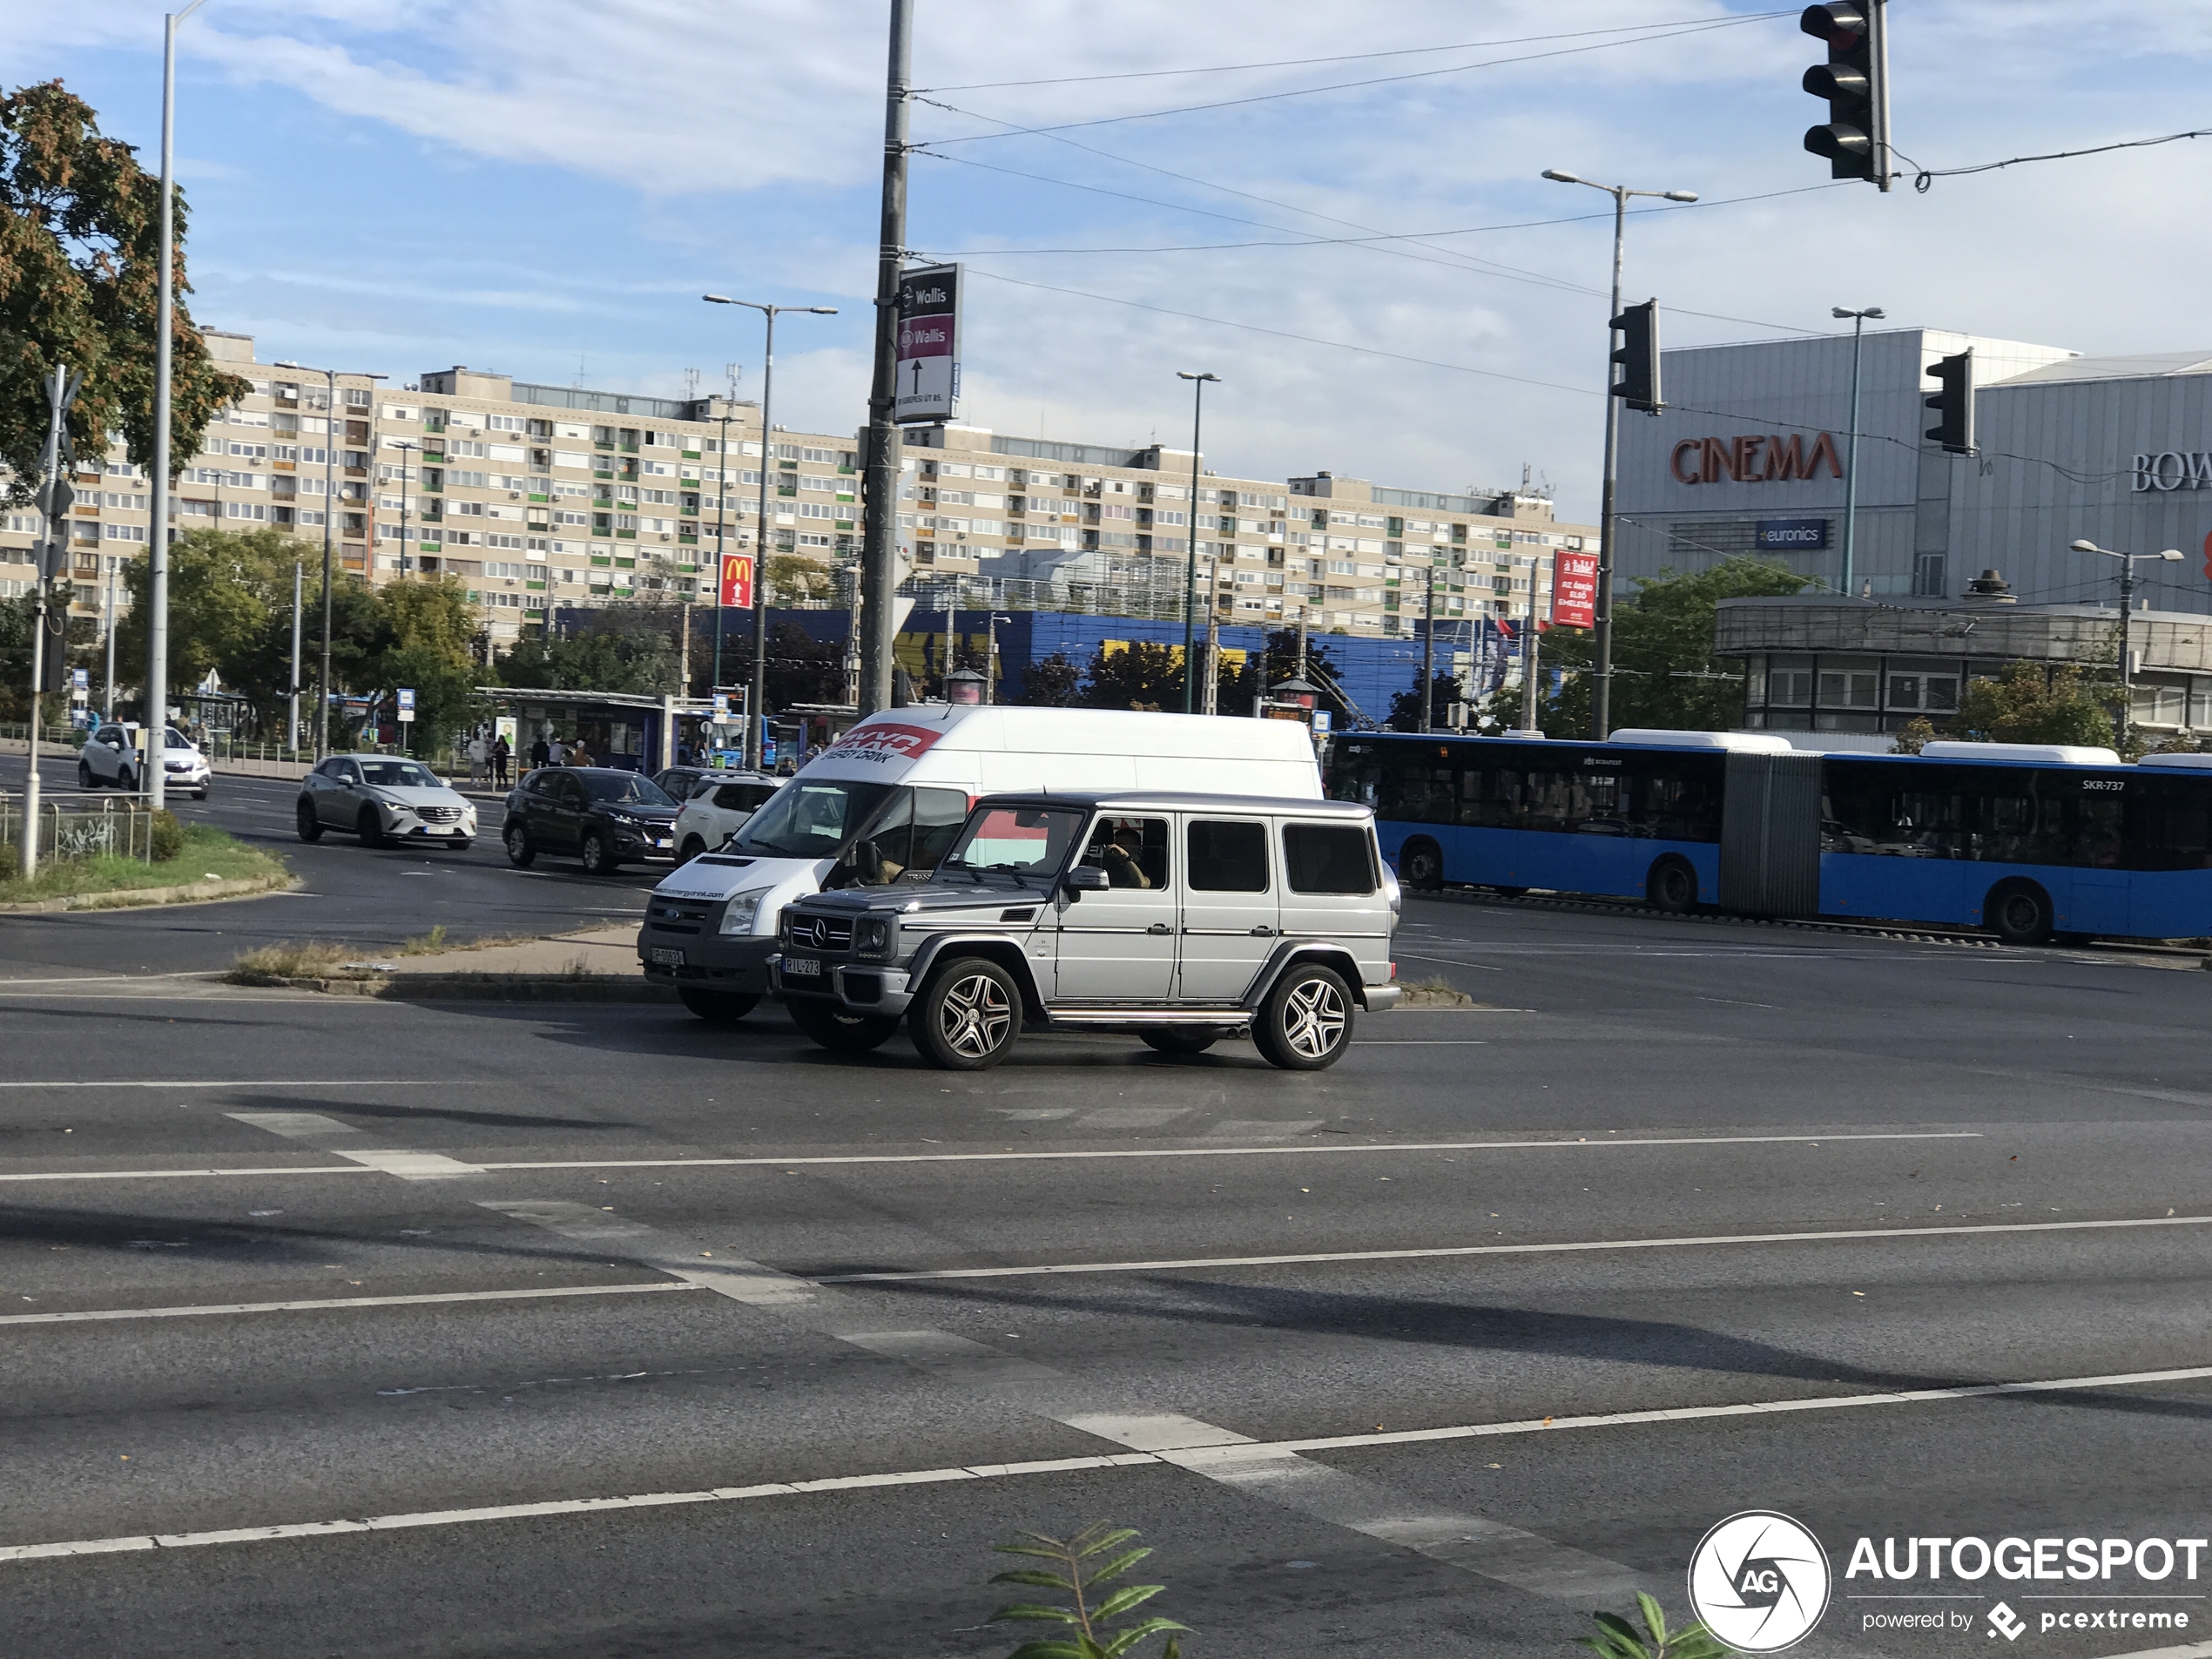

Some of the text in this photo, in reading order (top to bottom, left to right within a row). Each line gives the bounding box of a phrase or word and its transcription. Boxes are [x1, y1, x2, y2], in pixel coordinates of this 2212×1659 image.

[916, 287, 947, 304] Wallis
[914, 328, 946, 344] Wallis
[1670, 432, 1843, 484] CINEMA
[1767, 526, 1819, 541] euronics
[821, 749, 894, 764] ENERGY DRINK
[2082, 780, 2125, 791] SKR-737
[786, 959, 819, 974] RIL-273
